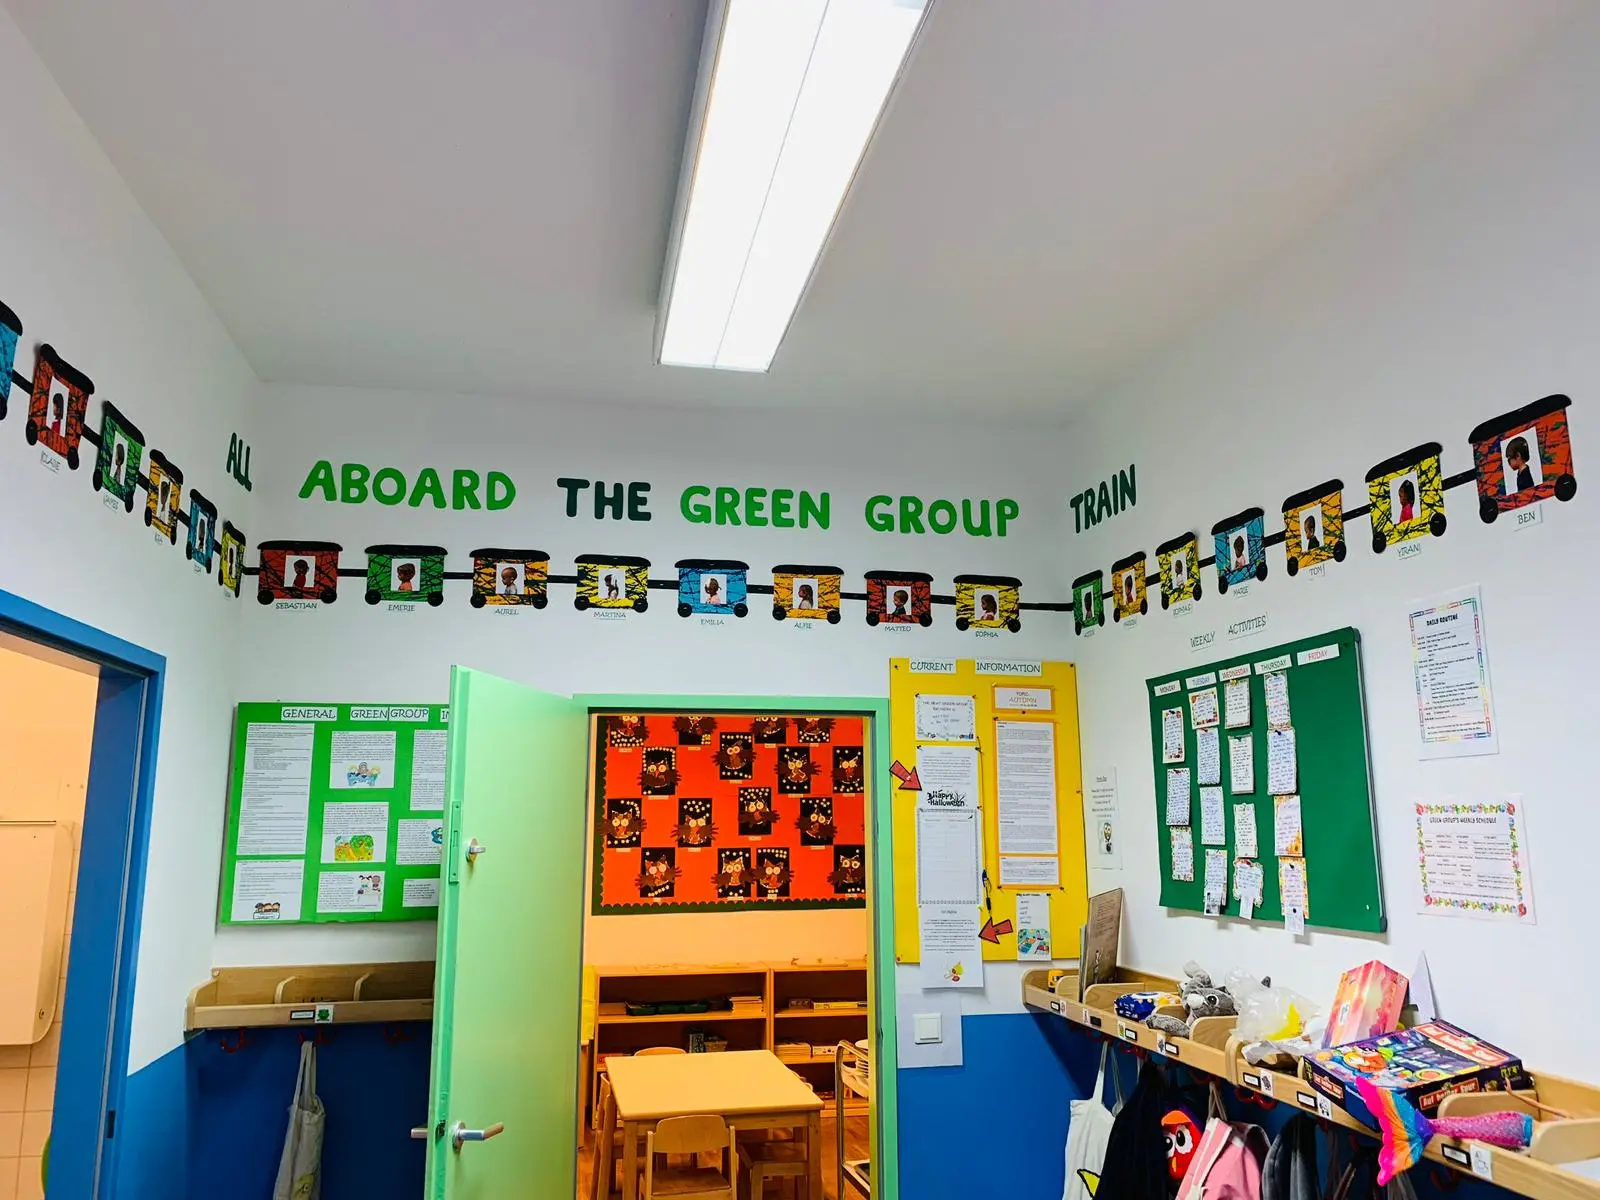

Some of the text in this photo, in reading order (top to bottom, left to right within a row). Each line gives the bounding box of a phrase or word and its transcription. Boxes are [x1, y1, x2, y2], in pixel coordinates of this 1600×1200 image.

[226, 432, 1136, 537] ALL ABOARD THE GREEN GROUP TRAIN
[1517, 511, 1535, 525] BEN
[275, 602, 317, 610] SEBASTIAN
[494, 608, 519, 616] AUREL
[975, 630, 999, 638] SOPHIA
[1190, 615, 1268, 648] WEEKLY ACTIVITIES
[910, 661, 1041, 673] CURRENT INFORMATION
[1159, 649, 1328, 694] MONDAY TUESDAY WEDNESDAY THURSDAY FRIDAY
[282, 708, 429, 719] GENERAL GREEN GROUP
[928, 799, 965, 807] Halloween
